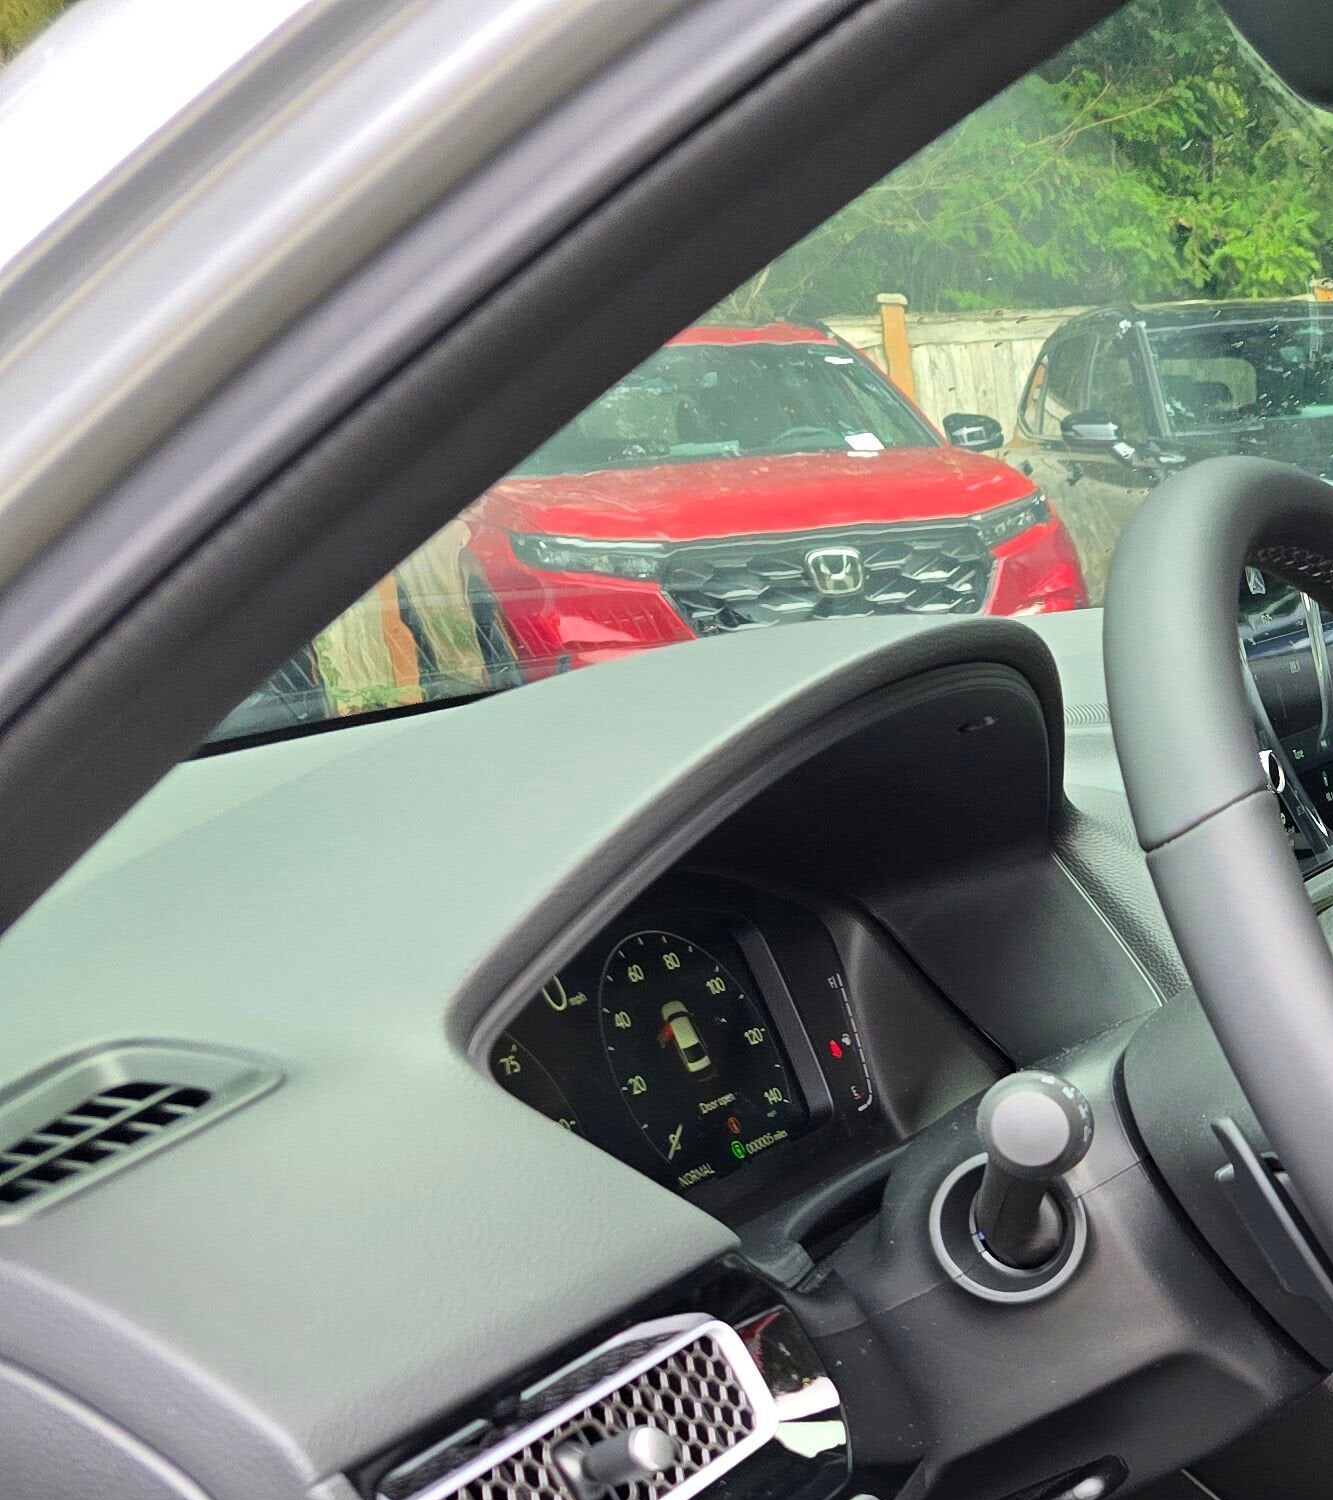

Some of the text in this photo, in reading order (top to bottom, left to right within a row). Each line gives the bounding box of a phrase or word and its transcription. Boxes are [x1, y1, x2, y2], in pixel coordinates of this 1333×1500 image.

[662, 952, 680, 970] 80
[627, 964, 645, 983] 60
[706, 976, 727, 995] 100
[614, 1011, 632, 1029] 40
[744, 1027, 764, 1046] 120
[498, 1055, 521, 1075] 75
[627, 1075, 647, 1095] 20
[763, 1087, 783, 1105] 140
[678, 1162, 716, 1188] NORMAL
